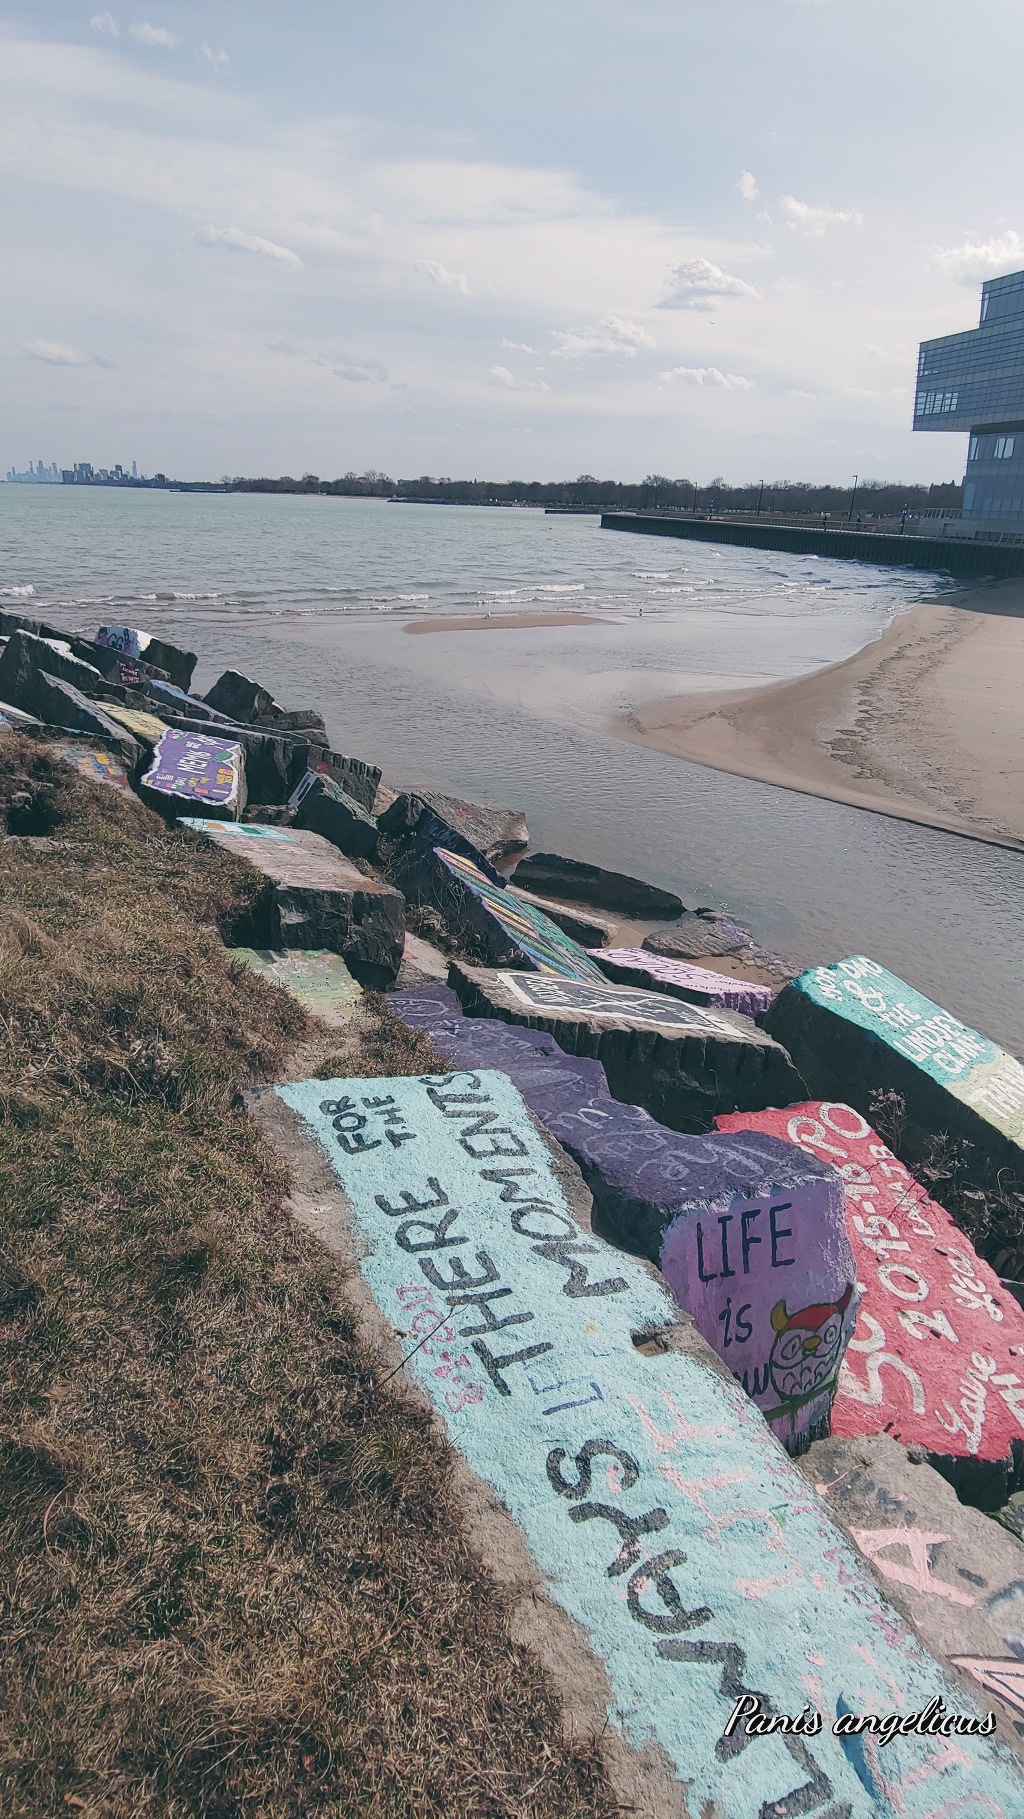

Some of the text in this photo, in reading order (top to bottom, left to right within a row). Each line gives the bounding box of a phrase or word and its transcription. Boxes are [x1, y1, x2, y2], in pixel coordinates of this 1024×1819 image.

[837, 957, 884, 979] DAD
[877, 1002, 922, 1033] THE
[319, 1095, 382, 1155] FOR
[361, 1095, 416, 1150] THE
[418, 1070, 630, 1299] MOMENTS
[695, 1202, 796, 1287] LIFE
[374, 1176, 554, 1397] THERE
[718, 1296, 754, 1348] is
